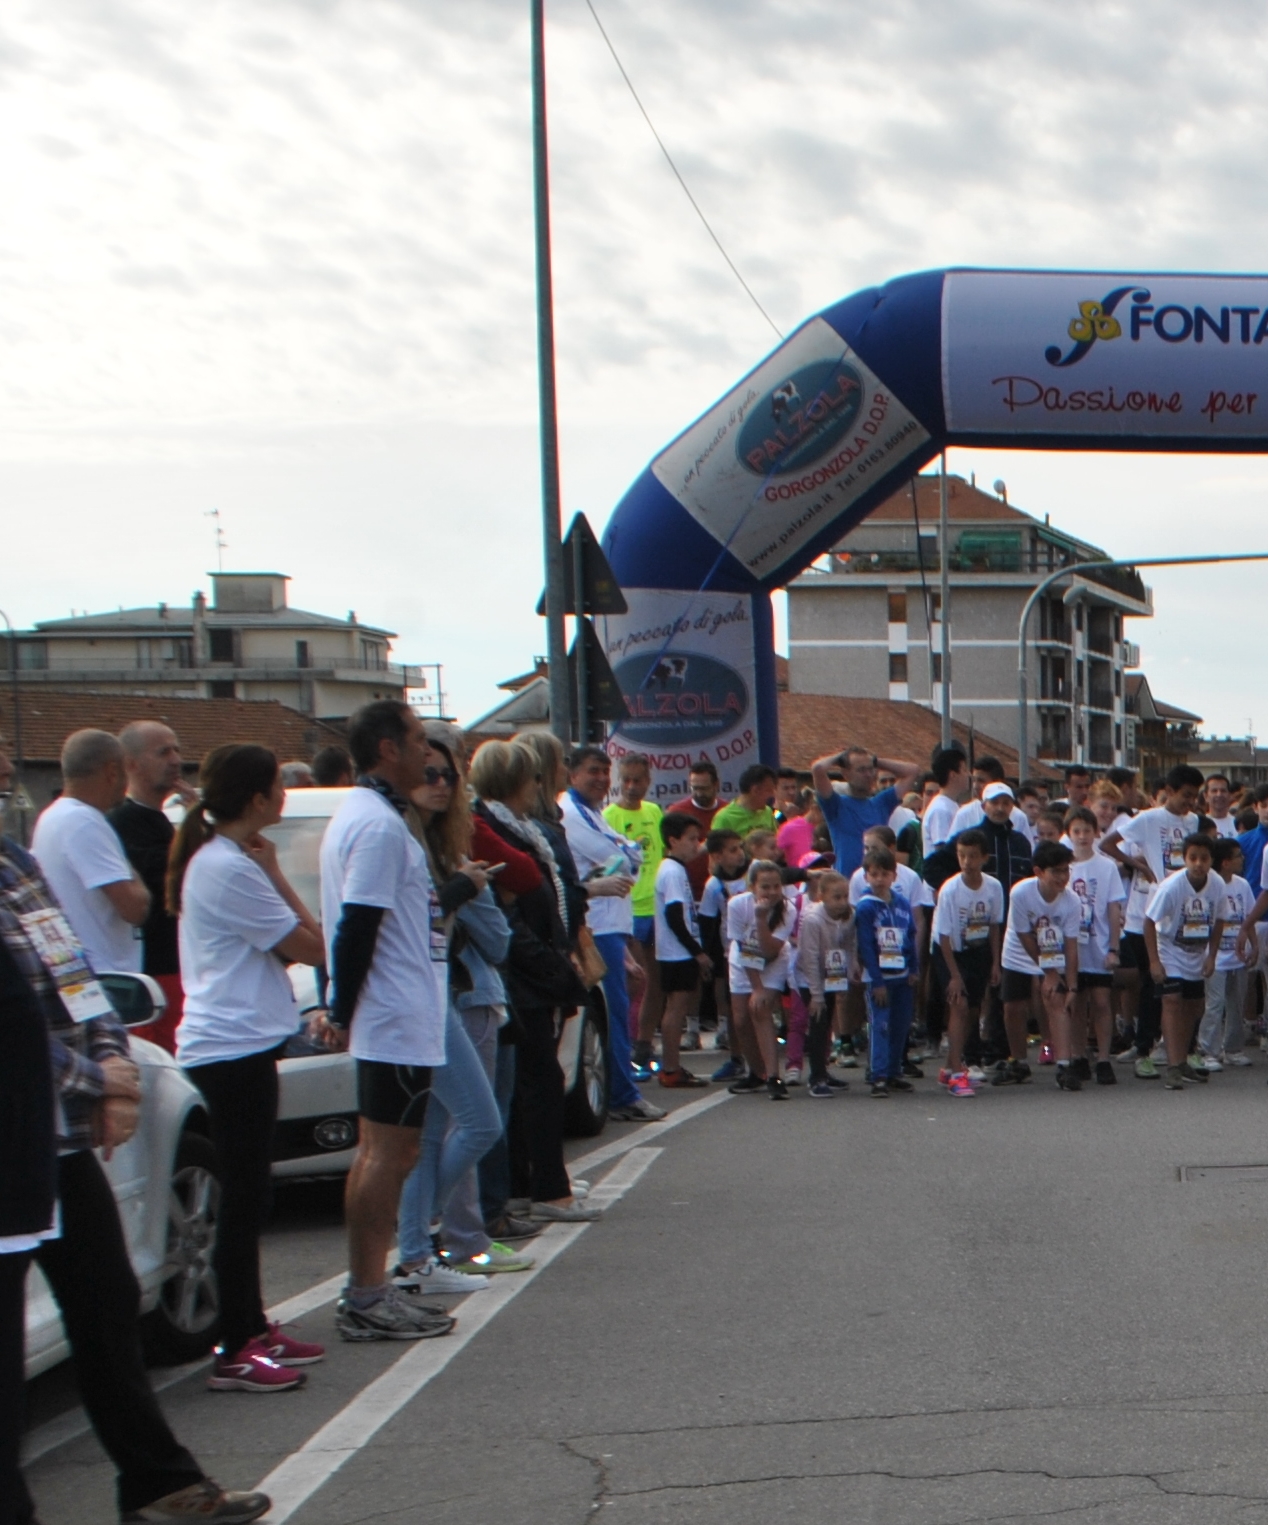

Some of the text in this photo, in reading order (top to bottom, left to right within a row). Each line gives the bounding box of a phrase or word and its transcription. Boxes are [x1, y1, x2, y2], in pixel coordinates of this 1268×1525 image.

[746, 374, 860, 472] PALZOLA
[992, 375, 1182, 414] Passione
[1201, 389, 1258, 422] per
[747, 491, 834, 568] www.palzola.it
[835, 474, 859, 493] Tel.
[857, 420, 918, 475] 0163.80940
[764, 435, 869, 503] GORGONZOLA
[694, 607, 710, 630] di
[624, 691, 742, 717] ALZOLA
